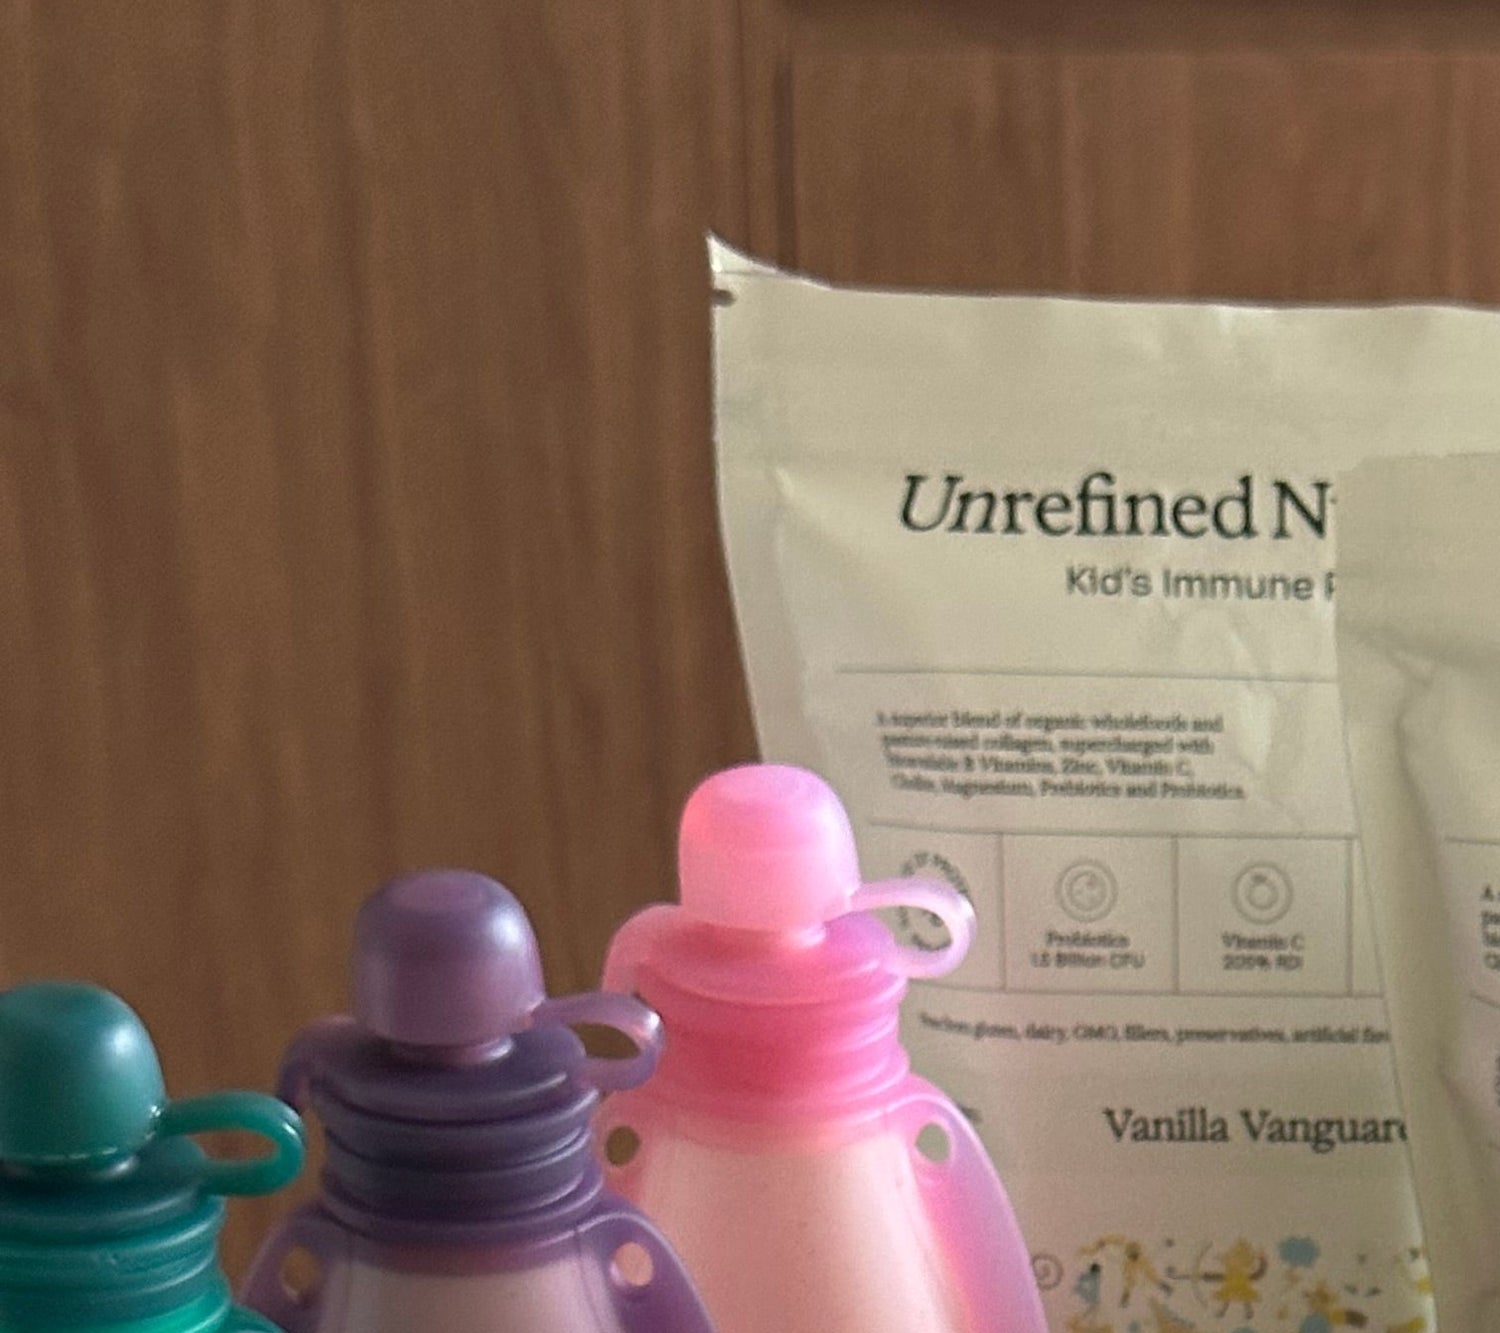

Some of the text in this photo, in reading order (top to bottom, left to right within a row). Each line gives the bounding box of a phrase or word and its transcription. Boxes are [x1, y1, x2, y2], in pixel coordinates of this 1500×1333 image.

[901, 471, 1337, 540] Unrefined N
[1065, 564, 1153, 598] Kid's
[1162, 568, 1314, 602] Immune
[1102, 1107, 1230, 1143] Vanilla
